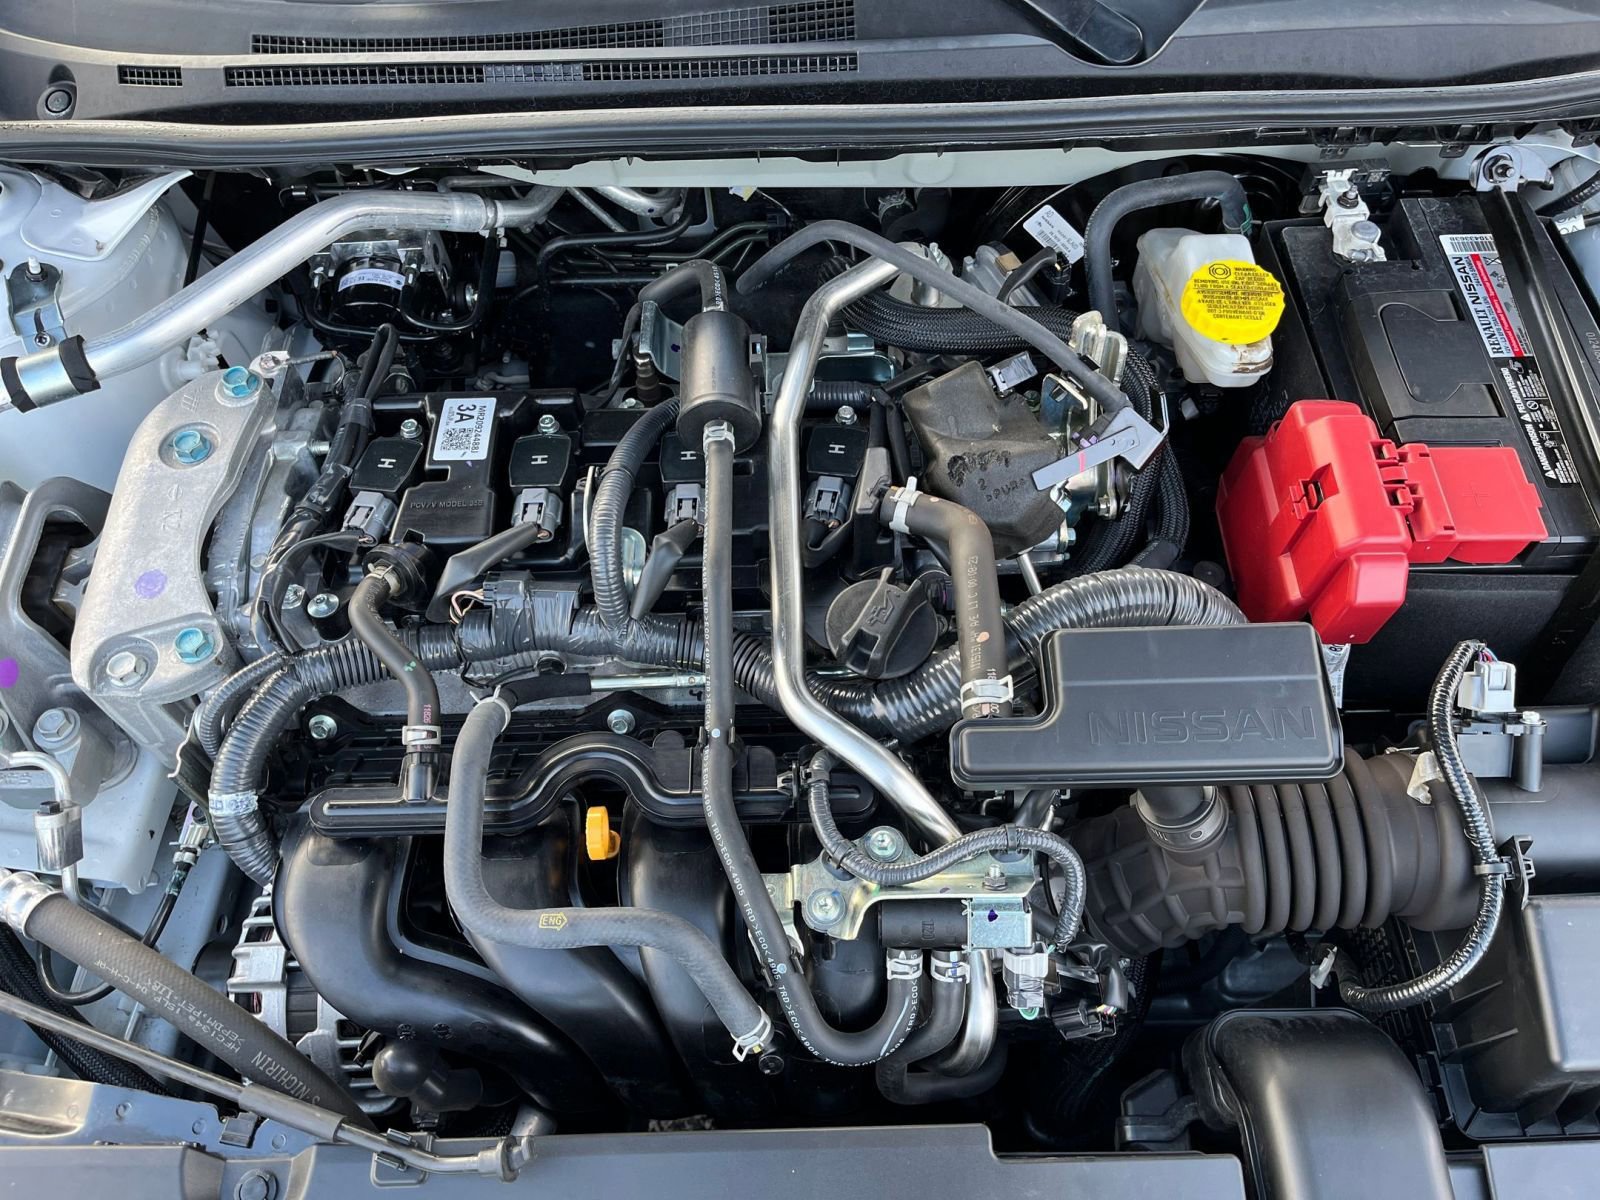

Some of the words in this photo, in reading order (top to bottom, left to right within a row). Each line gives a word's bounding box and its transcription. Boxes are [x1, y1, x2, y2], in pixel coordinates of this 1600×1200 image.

[1451, 256, 1482, 303] NISSAN
[1475, 308, 1503, 354] RENAULT
[455, 404, 477, 423] 3A
[1088, 706, 1317, 746] NISSAN
[542, 916, 562, 926] ENG
[702, 746, 714, 818] TRD>ECO<4905
[711, 823, 745, 896] TRD>ECO<4905
[743, 903, 782, 980] TRD>ECO<4905
[778, 985, 820, 1056] TRD>ECO<4905
